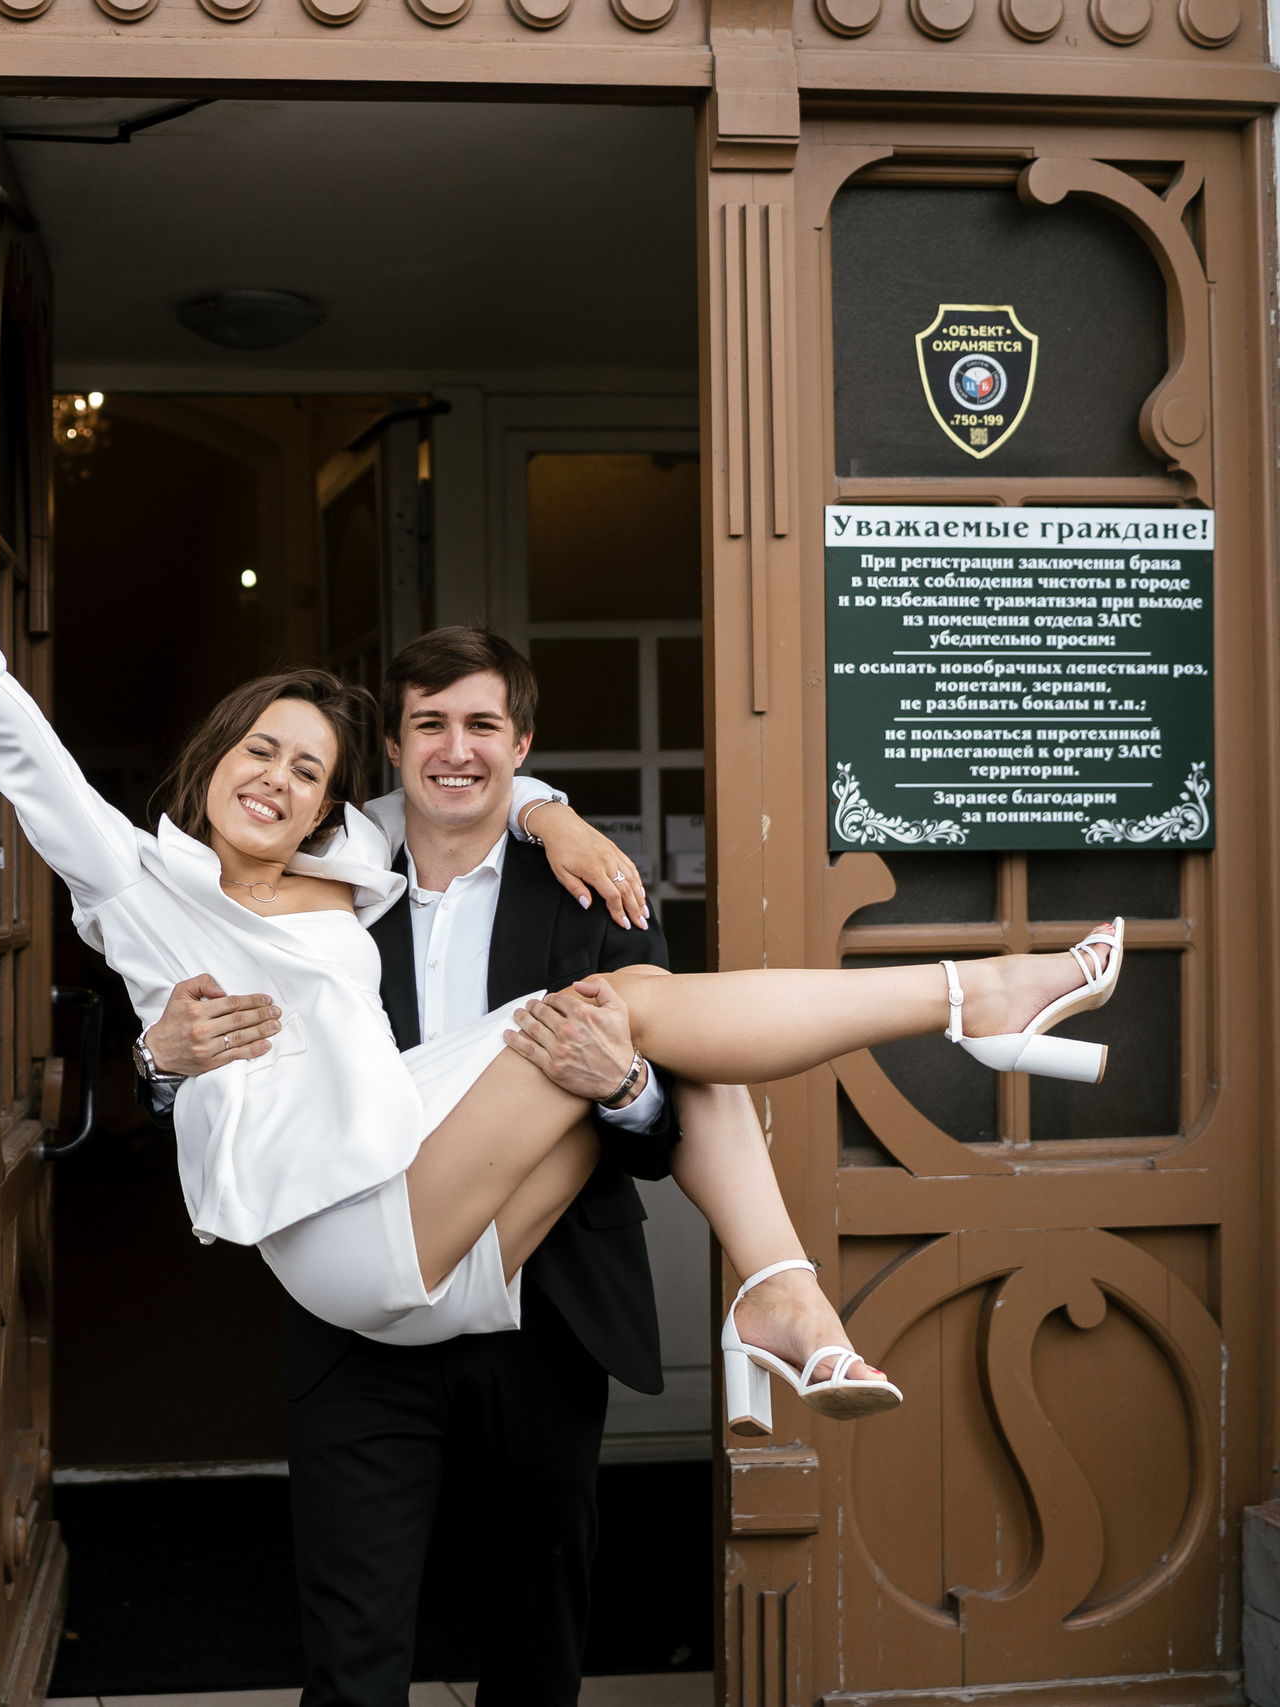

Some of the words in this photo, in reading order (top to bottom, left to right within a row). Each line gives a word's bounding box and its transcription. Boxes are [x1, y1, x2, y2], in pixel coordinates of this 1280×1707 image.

[949, 325, 1005, 337] ОБЪЕКТ
[932, 340, 1023, 352] ОХРАНЯЕТСЯ
[832, 515, 1029, 538] Уважаемые
[1040, 519, 1208, 544] граждане!
[860, 554, 897, 572] При
[900, 557, 1014, 573] регистрации
[1018, 558, 1126, 571] заключения
[1129, 554, 1182, 573] брака
[851, 576, 863, 588] в
[867, 576, 919, 590] целях
[924, 573, 1033, 590] соблюдения
[1037, 578, 1112, 590] чистоты
[1115, 578, 1127, 590] в
[1131, 577, 1190, 591] городе
[838, 596, 850, 607] и
[854, 596, 877, 607] во
[881, 592, 980, 607] избежание
[984, 597, 1097, 610] травматизма
[1101, 597, 1135, 612] при
[1139, 597, 1202, 609] выходе
[902, 615, 924, 627] из
[927, 615, 1030, 629] помещения
[1033, 616, 1094, 629] отдела
[1097, 613, 1142, 628] ЗАГС
[929, 631, 1042, 649] убедительно
[1045, 635, 1116, 650] просим:
[833, 663, 856, 675] не
[858, 663, 937, 675] осыпать
[940, 659, 1063, 678] новобрачных
[1065, 664, 1169, 675] лепестками
[934, 682, 1028, 693] монетами,
[1031, 682, 1112, 696] зернами,
[900, 700, 922, 711] не
[925, 695, 1019, 714] разбивать
[1021, 695, 1090, 711] бокалы
[1093, 700, 1105, 711] и
[884, 730, 907, 741] не
[910, 730, 1033, 741] пользоваться
[1036, 727, 1161, 743] пиротехникой
[884, 748, 907, 759] на
[909, 745, 1034, 762] прилегающей
[1038, 748, 1050, 759] к
[1052, 748, 1114, 762] органу
[1117, 745, 1162, 759] ЗАГС
[969, 766, 1080, 780] территории.
[933, 791, 1008, 807] Заранее
[1011, 789, 1117, 807] благодарим
[961, 812, 982, 823] за
[986, 811, 1090, 823] понимание.
